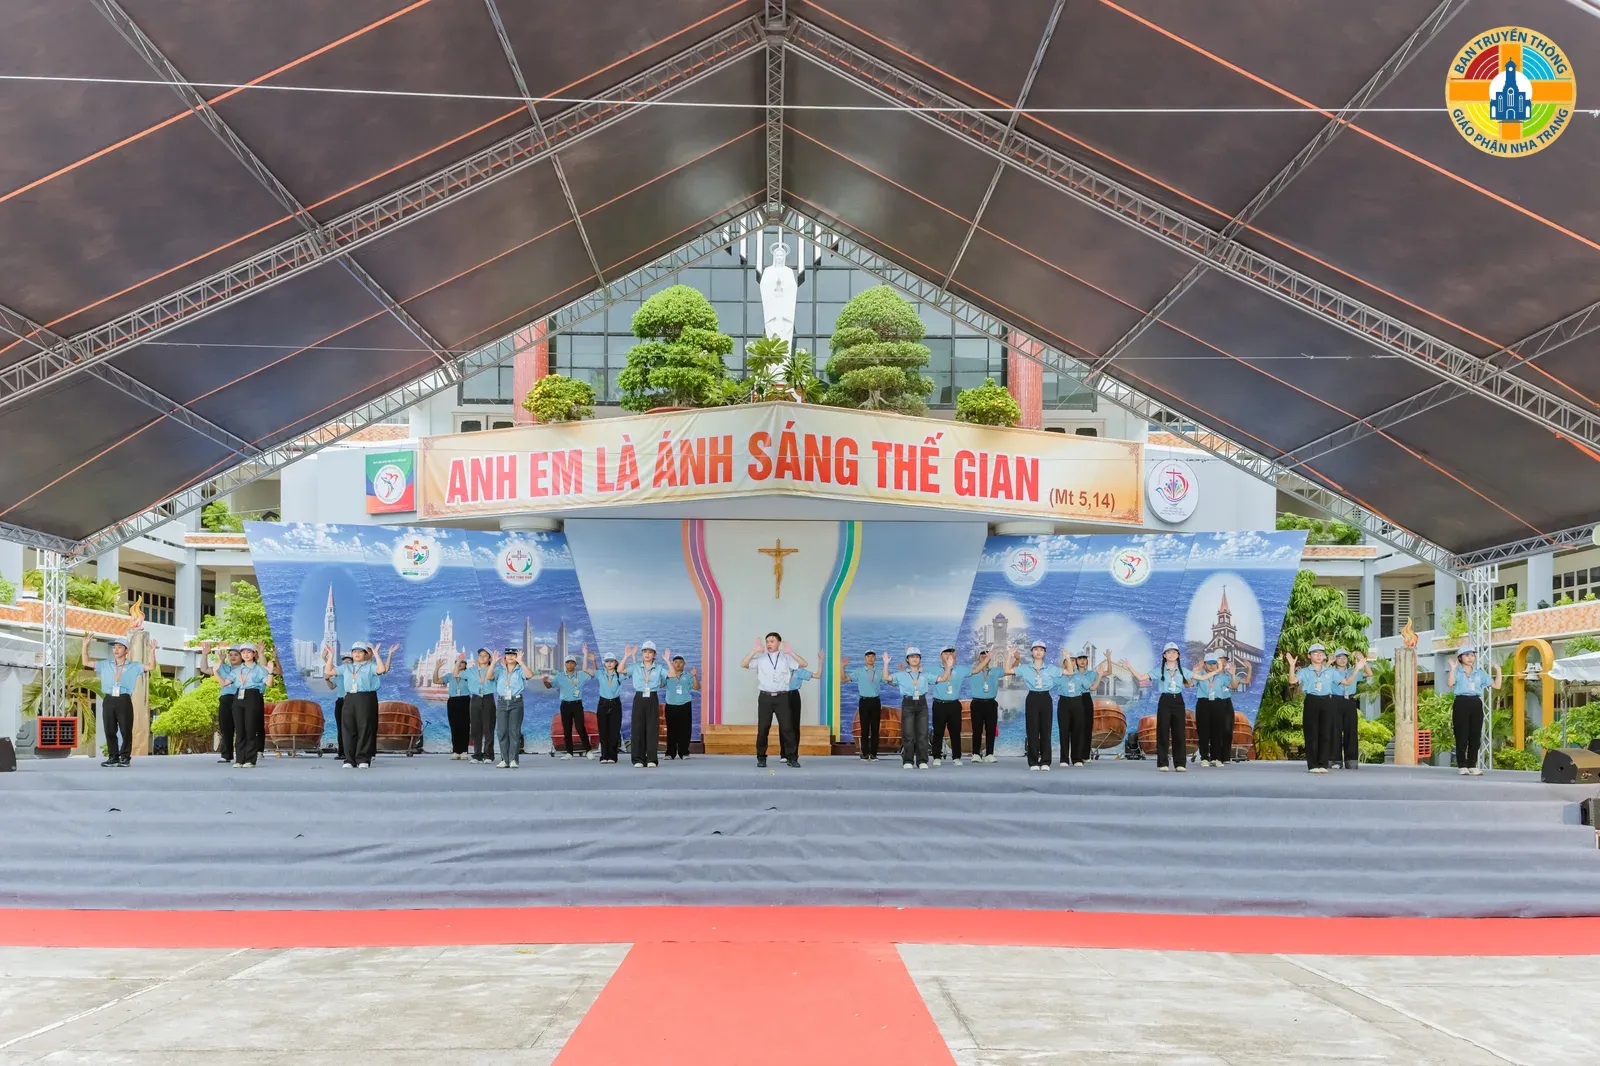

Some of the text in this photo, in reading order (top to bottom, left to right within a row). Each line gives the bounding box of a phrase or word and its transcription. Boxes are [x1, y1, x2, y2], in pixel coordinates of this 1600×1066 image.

[447, 421, 1116, 513] ANH EM LÀ ÁNH SÁNG THẾ GIAN (Mt 5,14)
